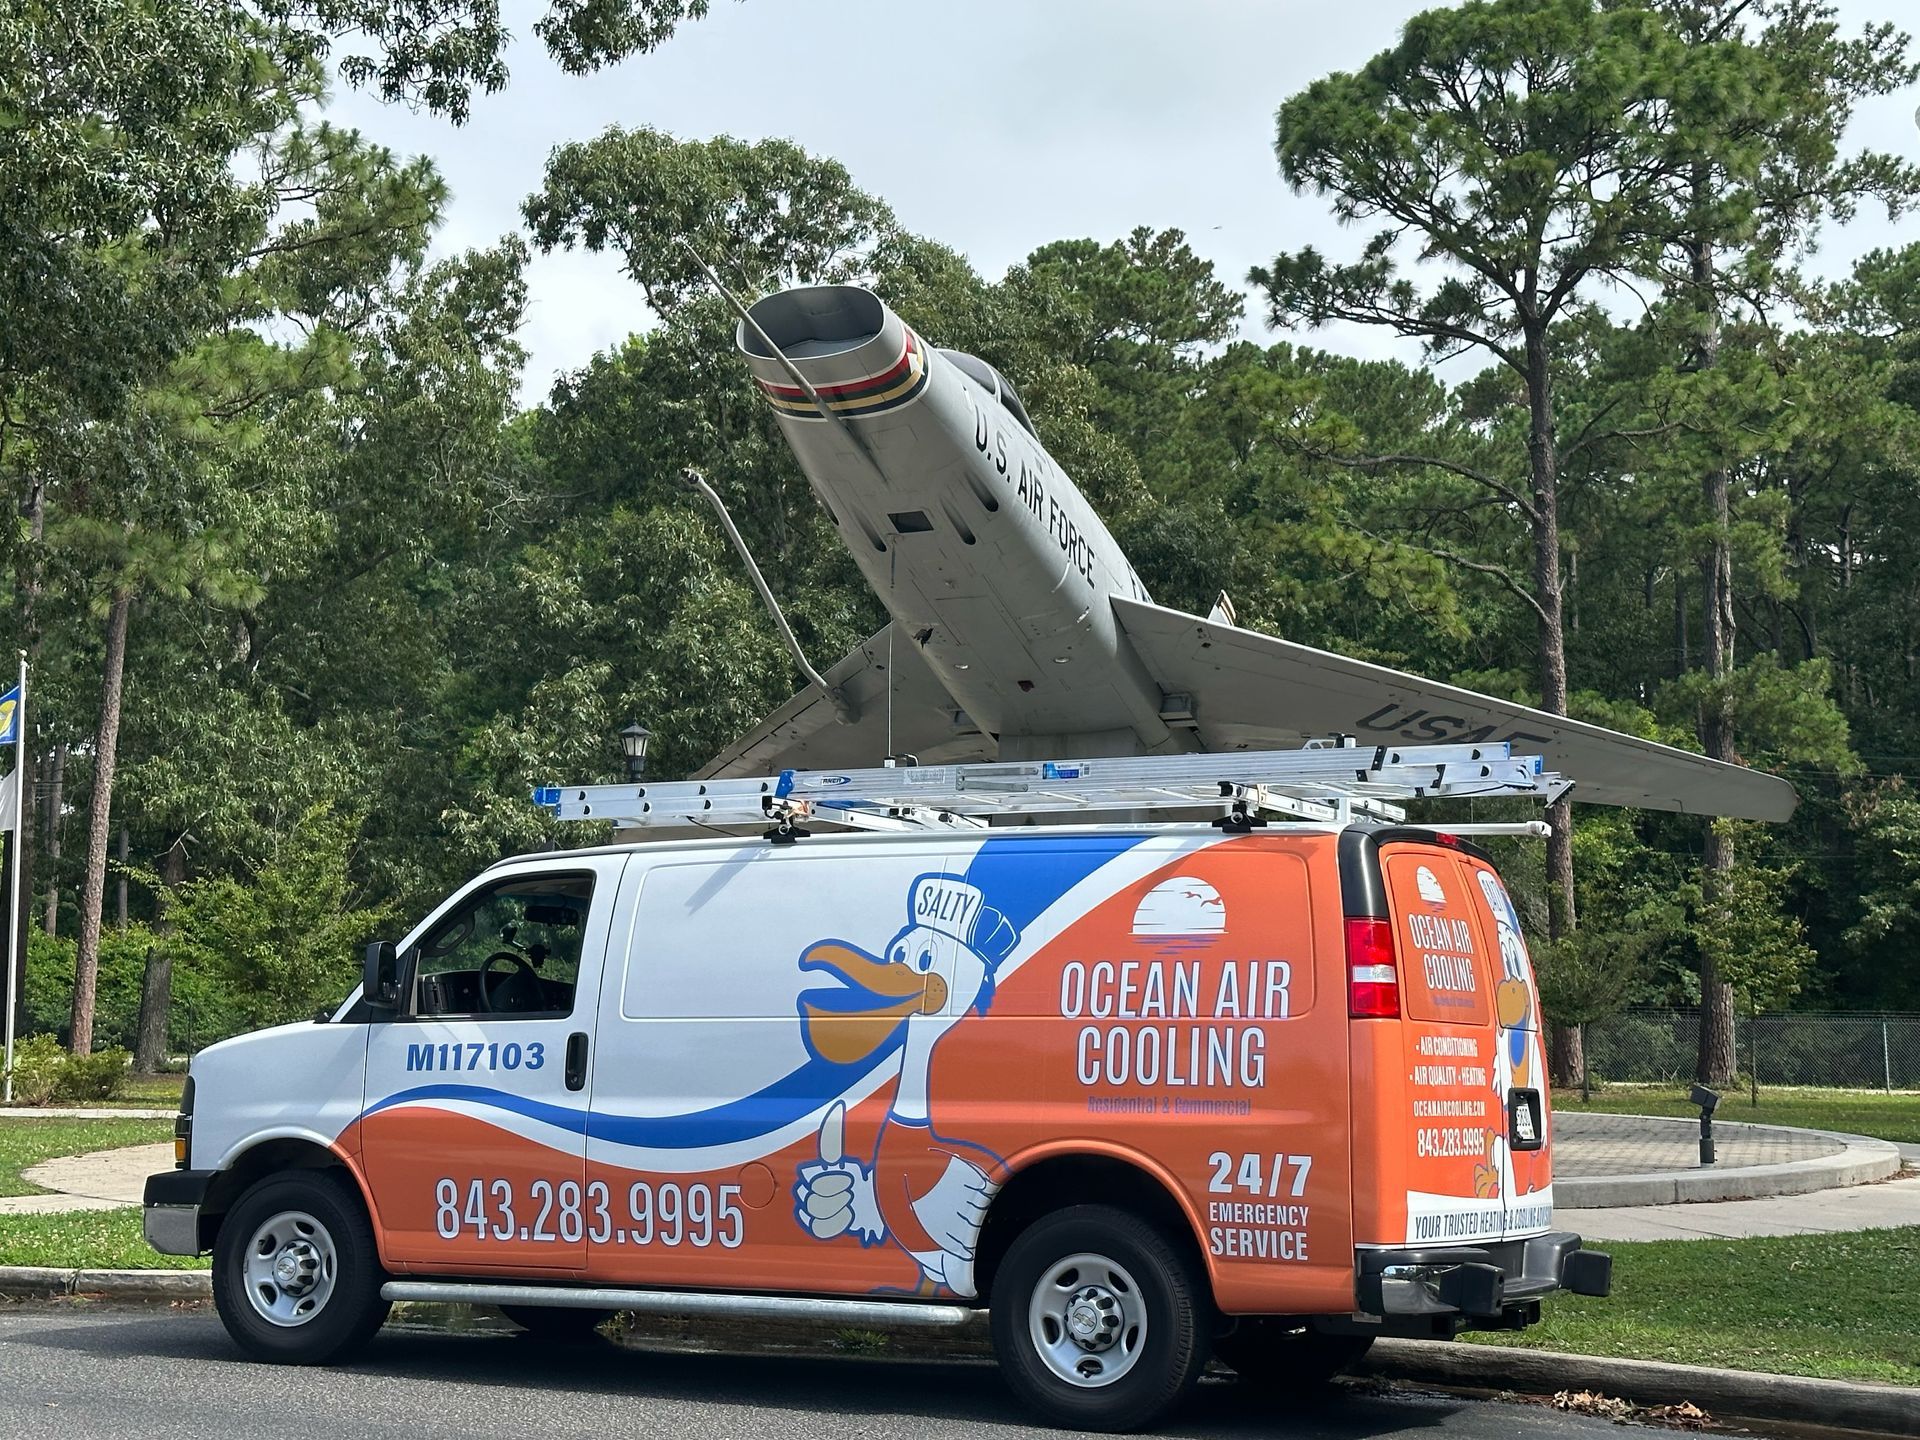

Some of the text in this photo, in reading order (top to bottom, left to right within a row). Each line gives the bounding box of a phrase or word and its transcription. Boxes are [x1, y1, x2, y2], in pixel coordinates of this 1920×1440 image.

[975, 404, 1095, 589] U.S. AIR FORCE
[917, 885, 975, 924] SALTY
[1408, 913, 1474, 954] OCEAN AIR
[1423, 954, 1476, 992] COOLING
[1060, 960, 1291, 1020] OCEAN AIR
[406, 1042, 545, 1071] M117103
[1077, 1026, 1265, 1087] COOLING
[1420, 1036, 1478, 1057] AIR CONDITIONING
[1414, 1065, 1486, 1087] AIR QUALITY HEATING
[1088, 1096, 1251, 1116] Residential & Commercial
[1413, 1100, 1486, 1117] OCEANAIRCOOLING.COM
[1417, 1128, 1485, 1157] 843.283.9995
[1208, 1151, 1312, 1197] 24/7
[436, 1178, 744, 1248] 843.283.9995
[1209, 1202, 1309, 1226] EMERGENCY
[1415, 1215, 1441, 1239] YOUR
[1443, 1211, 1478, 1236] TRUSTED
[1480, 1209, 1508, 1234] HEATING
[1514, 1206, 1536, 1229] COOLING
[1210, 1227, 1308, 1260] SERVICE
